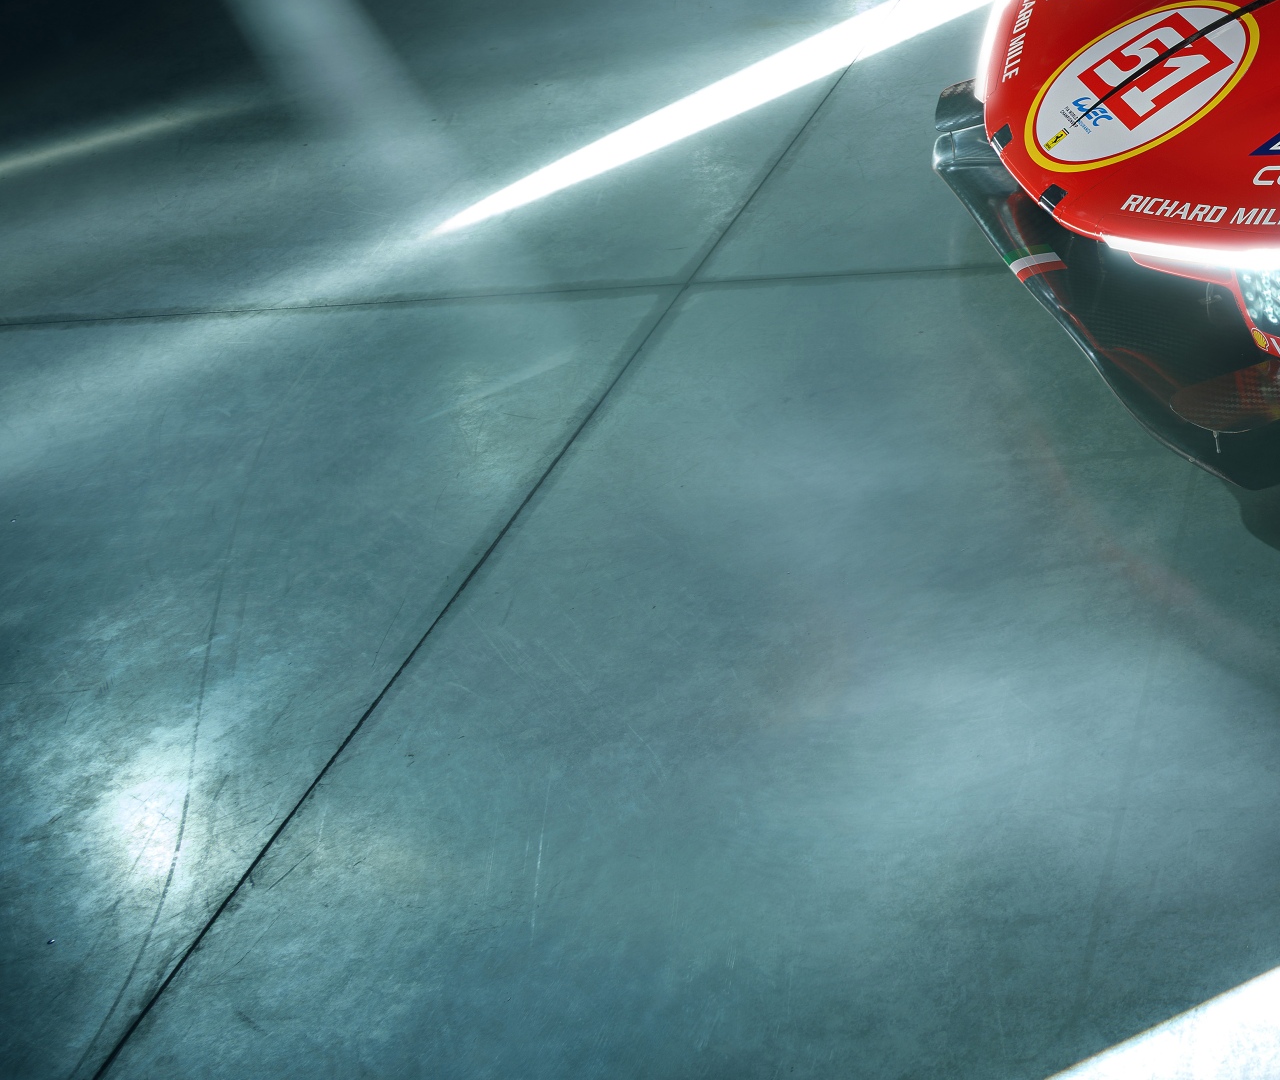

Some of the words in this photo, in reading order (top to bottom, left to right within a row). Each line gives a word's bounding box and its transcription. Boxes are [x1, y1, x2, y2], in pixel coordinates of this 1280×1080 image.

[1002, 32, 1027, 83] MILLE
[1093, 27, 1211, 117] 51
[1072, 96, 1113, 127] WEC
[1121, 194, 1227, 223] RICHARD
